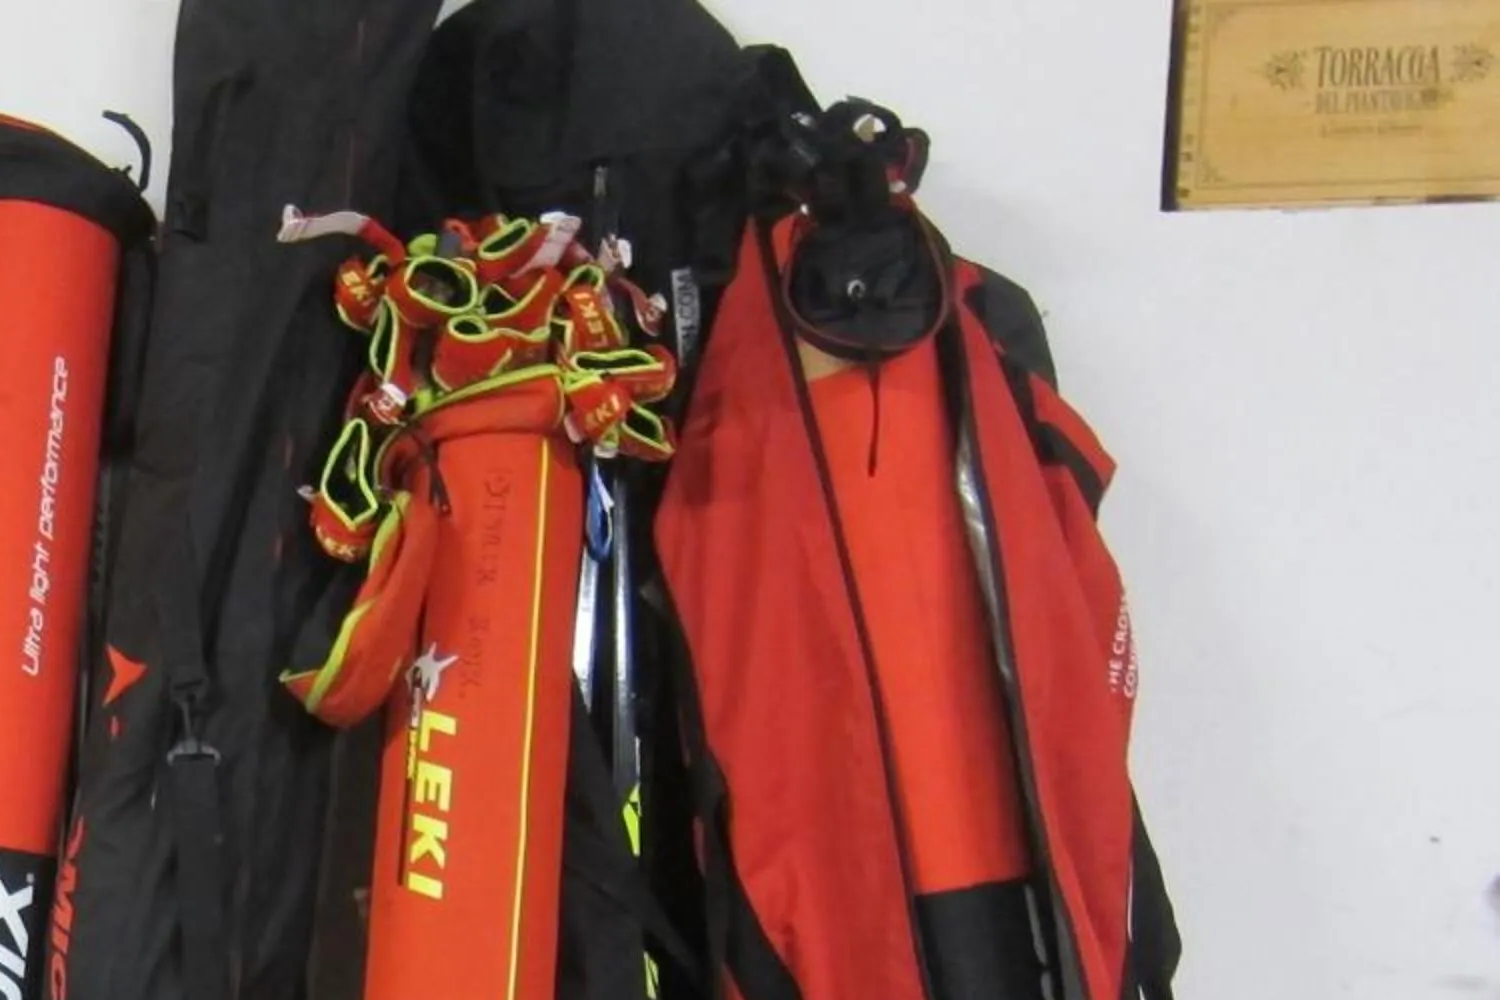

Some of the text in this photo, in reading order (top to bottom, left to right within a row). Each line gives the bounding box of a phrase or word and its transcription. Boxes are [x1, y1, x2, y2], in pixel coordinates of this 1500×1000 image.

[23, 355, 69, 677] Ultra light performance
[408, 708, 457, 900] LEKI
